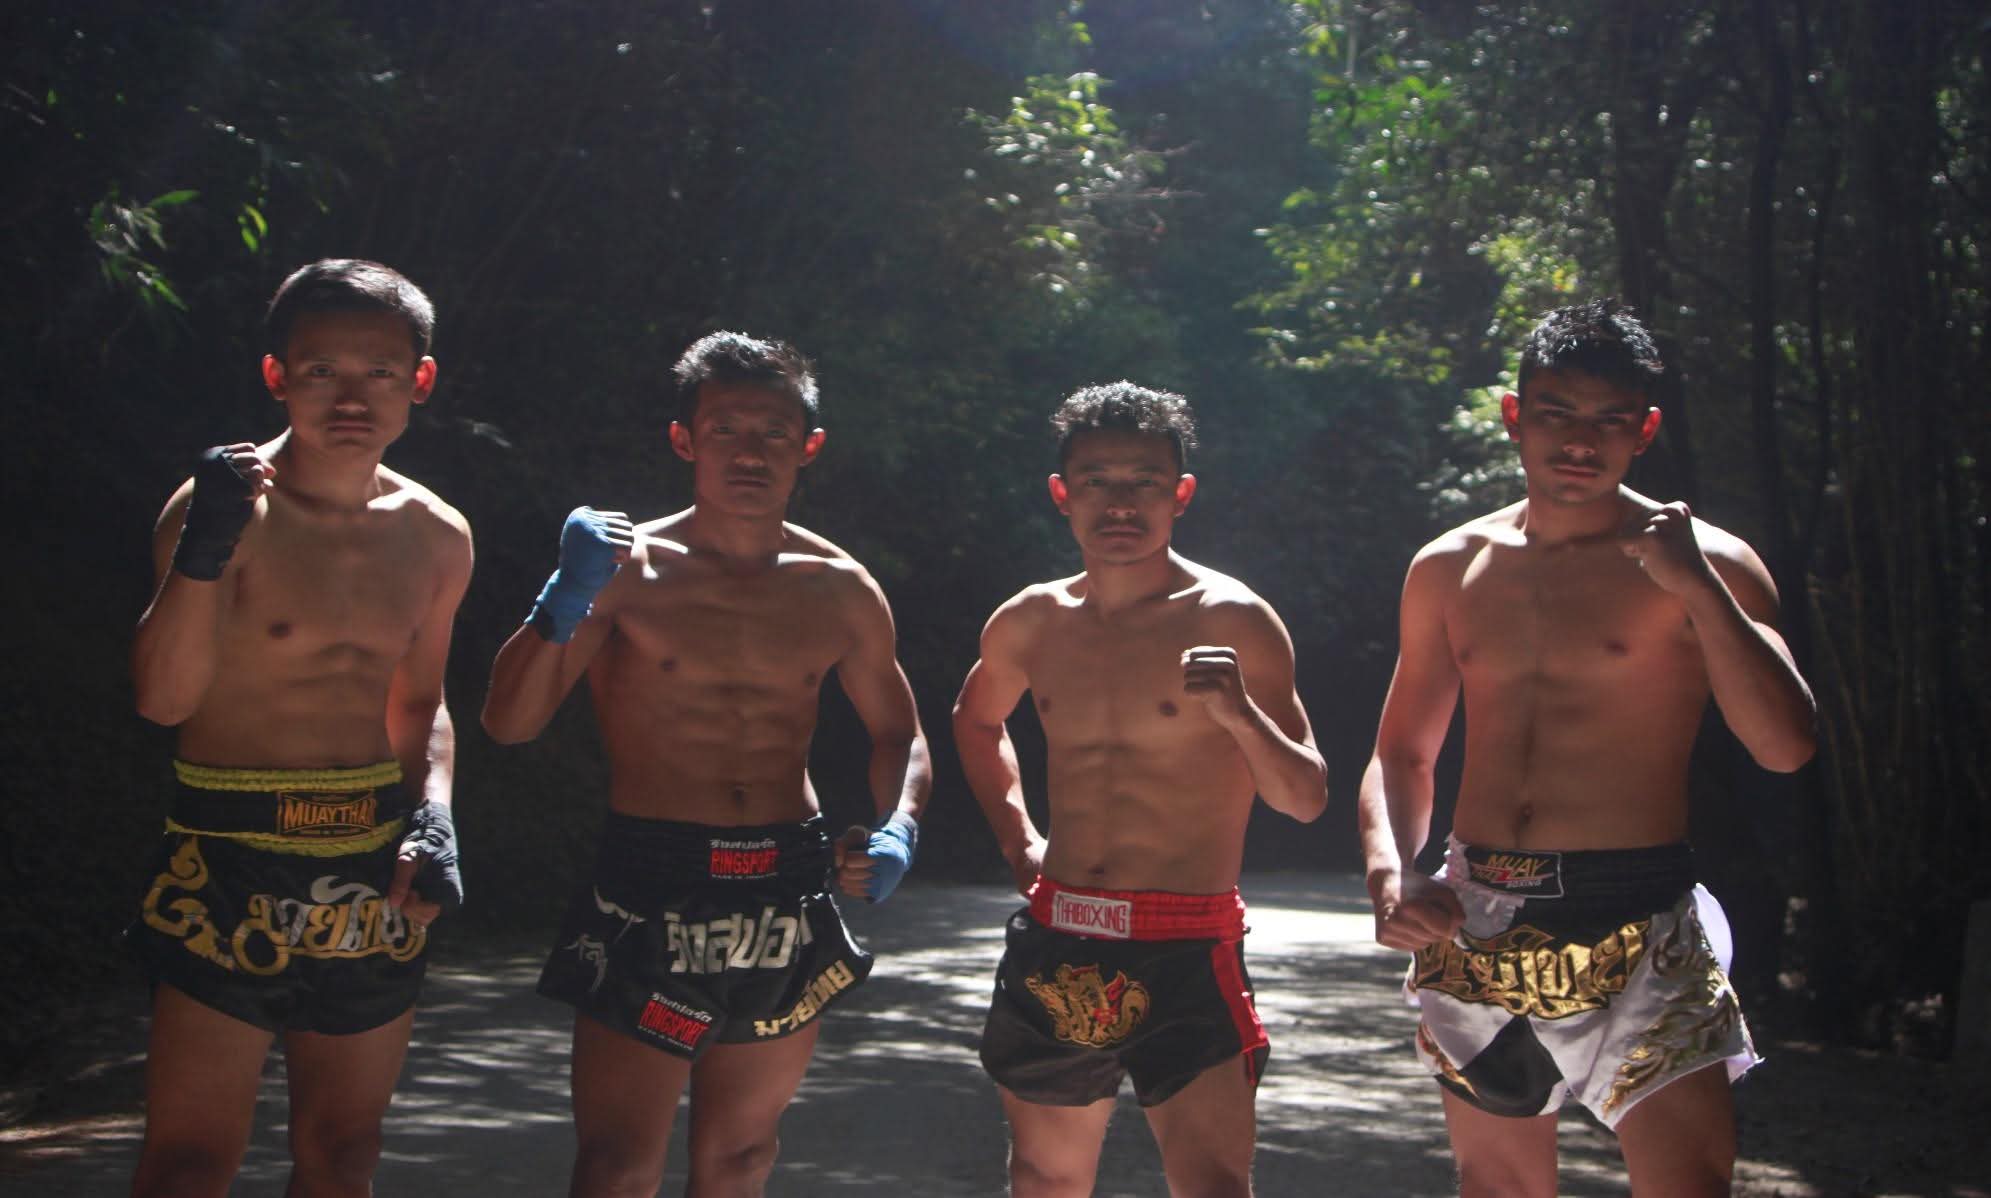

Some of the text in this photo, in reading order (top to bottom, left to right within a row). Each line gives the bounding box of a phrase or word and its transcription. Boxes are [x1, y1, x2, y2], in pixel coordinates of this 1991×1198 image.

[708, 848, 780, 875] RINGSPORT
[1487, 853, 1550, 878] MUAY
[638, 999, 711, 1048] RINGSPORT
